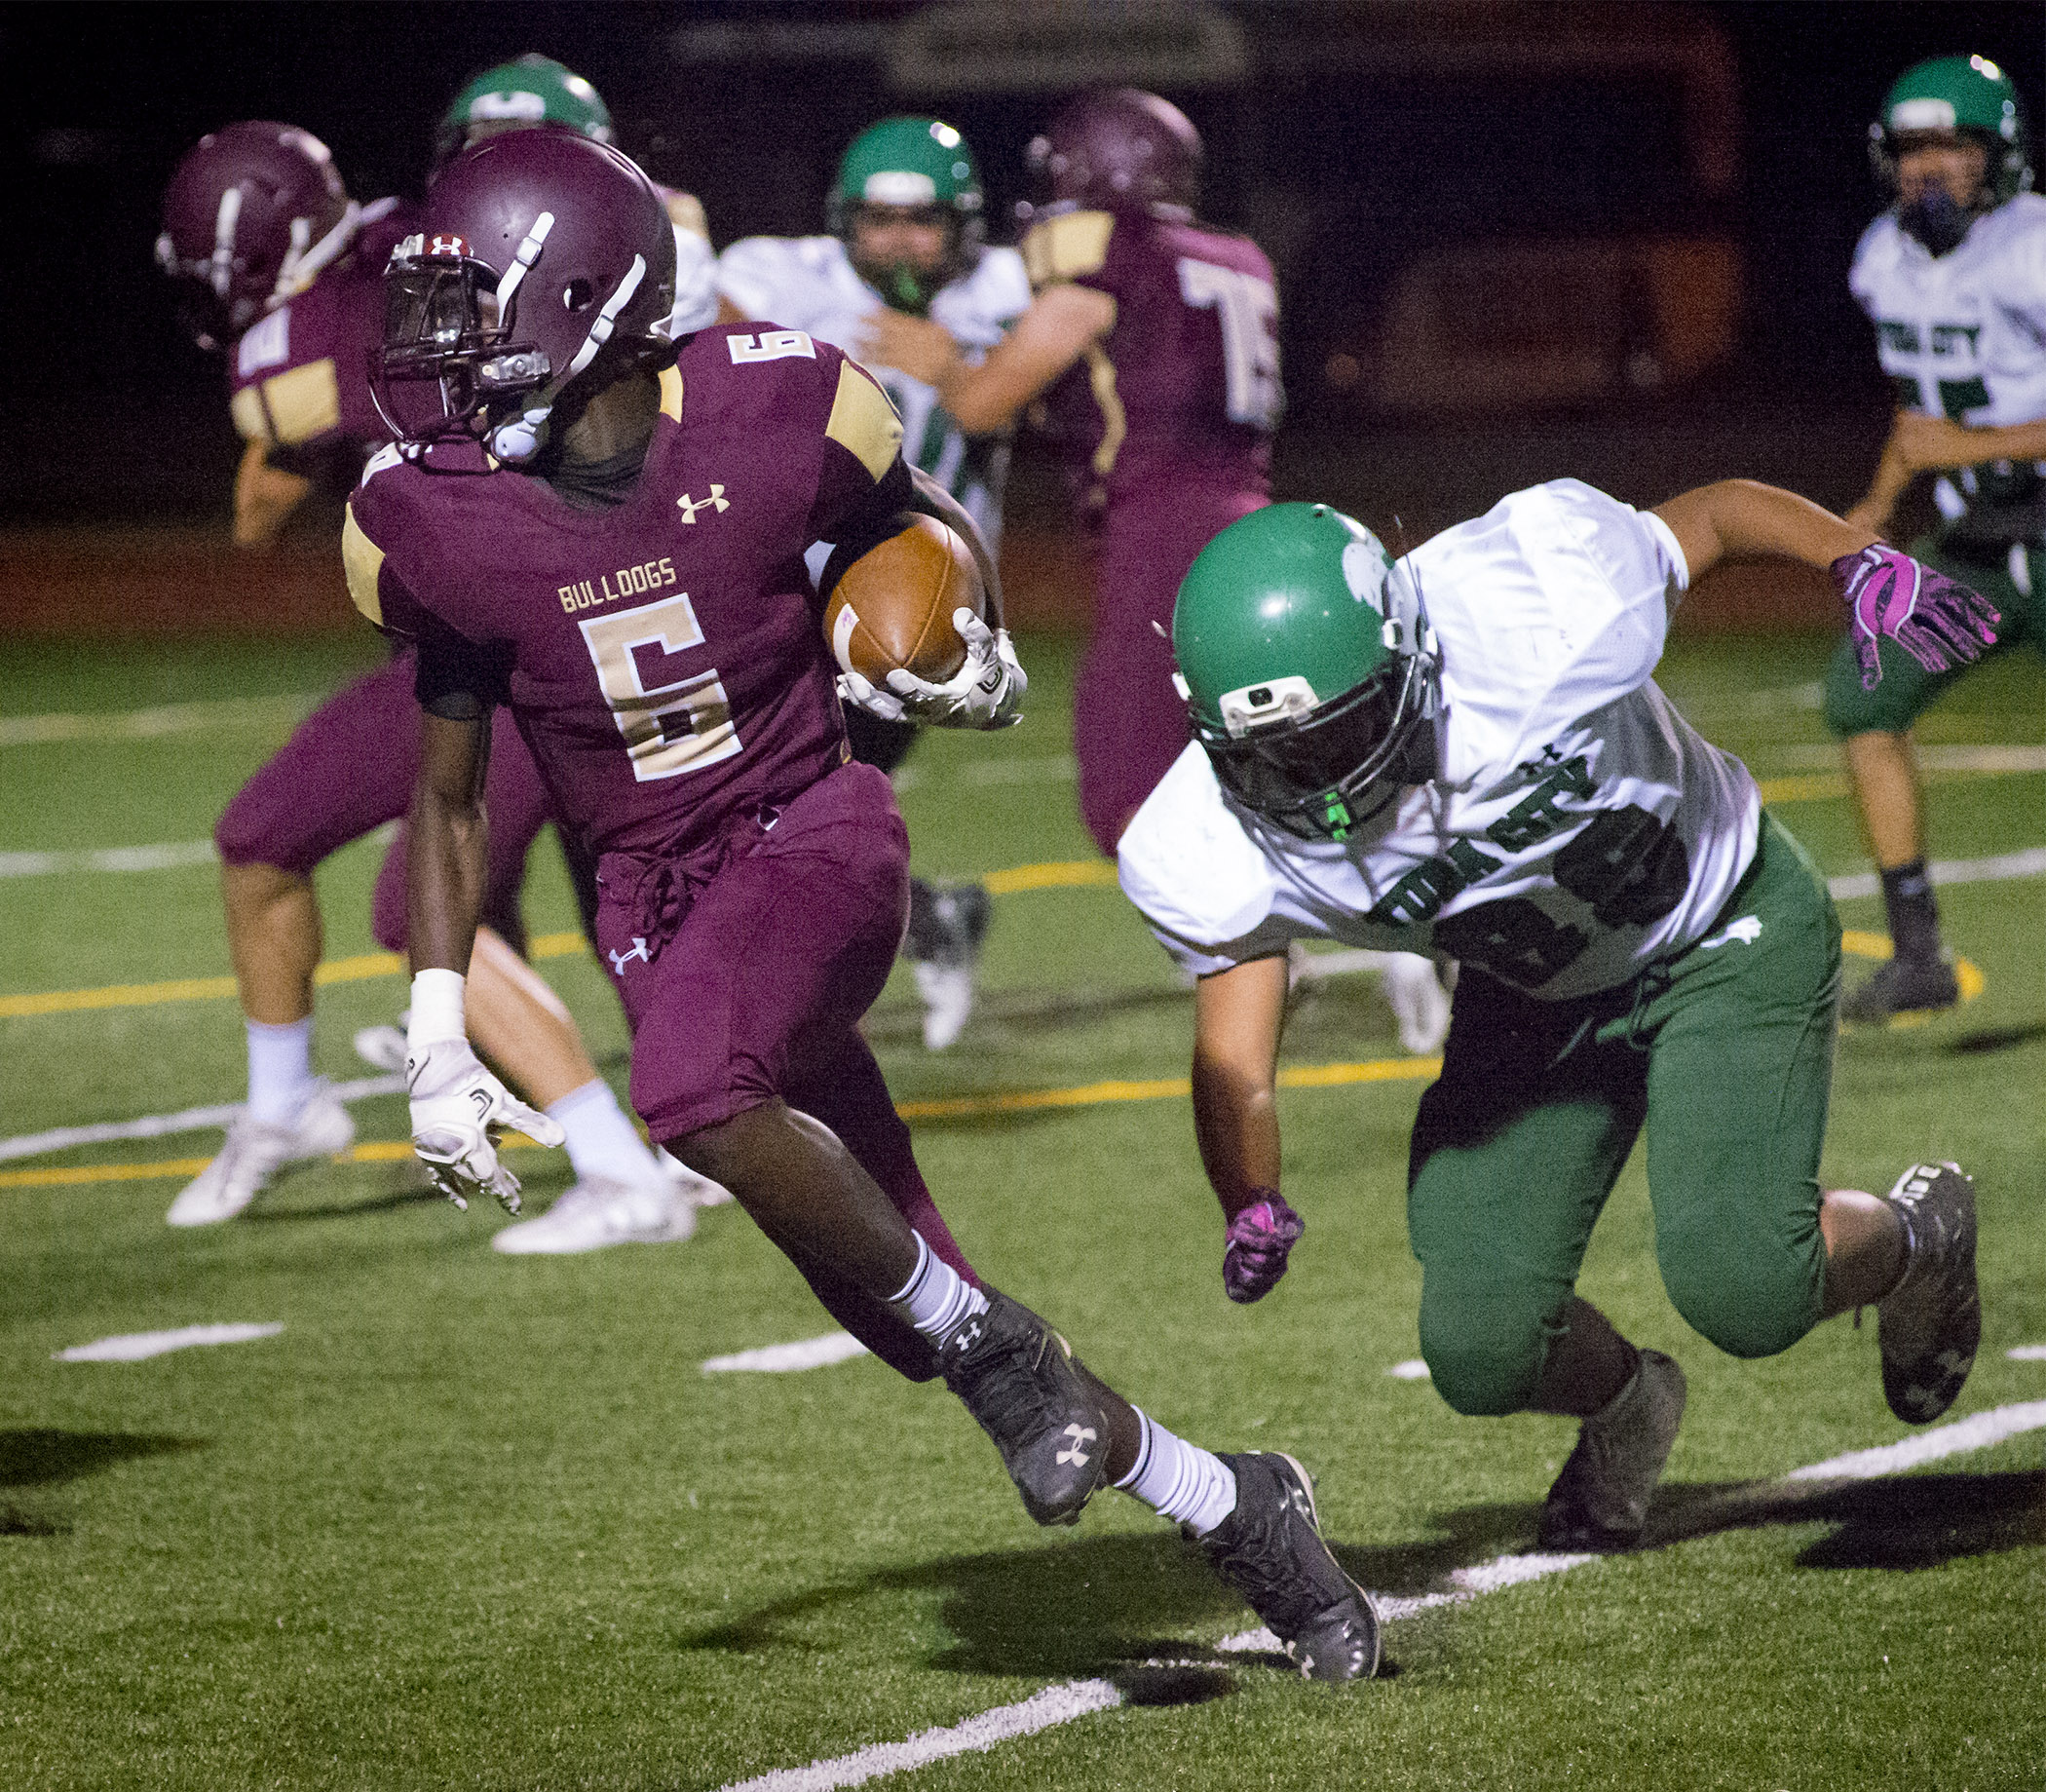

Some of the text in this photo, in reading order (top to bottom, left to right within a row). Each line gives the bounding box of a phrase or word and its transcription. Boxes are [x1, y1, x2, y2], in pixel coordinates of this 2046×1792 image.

[726, 330, 816, 364] 6
[557, 557, 676, 613] BULLDOGS
[578, 591, 743, 782] 6
